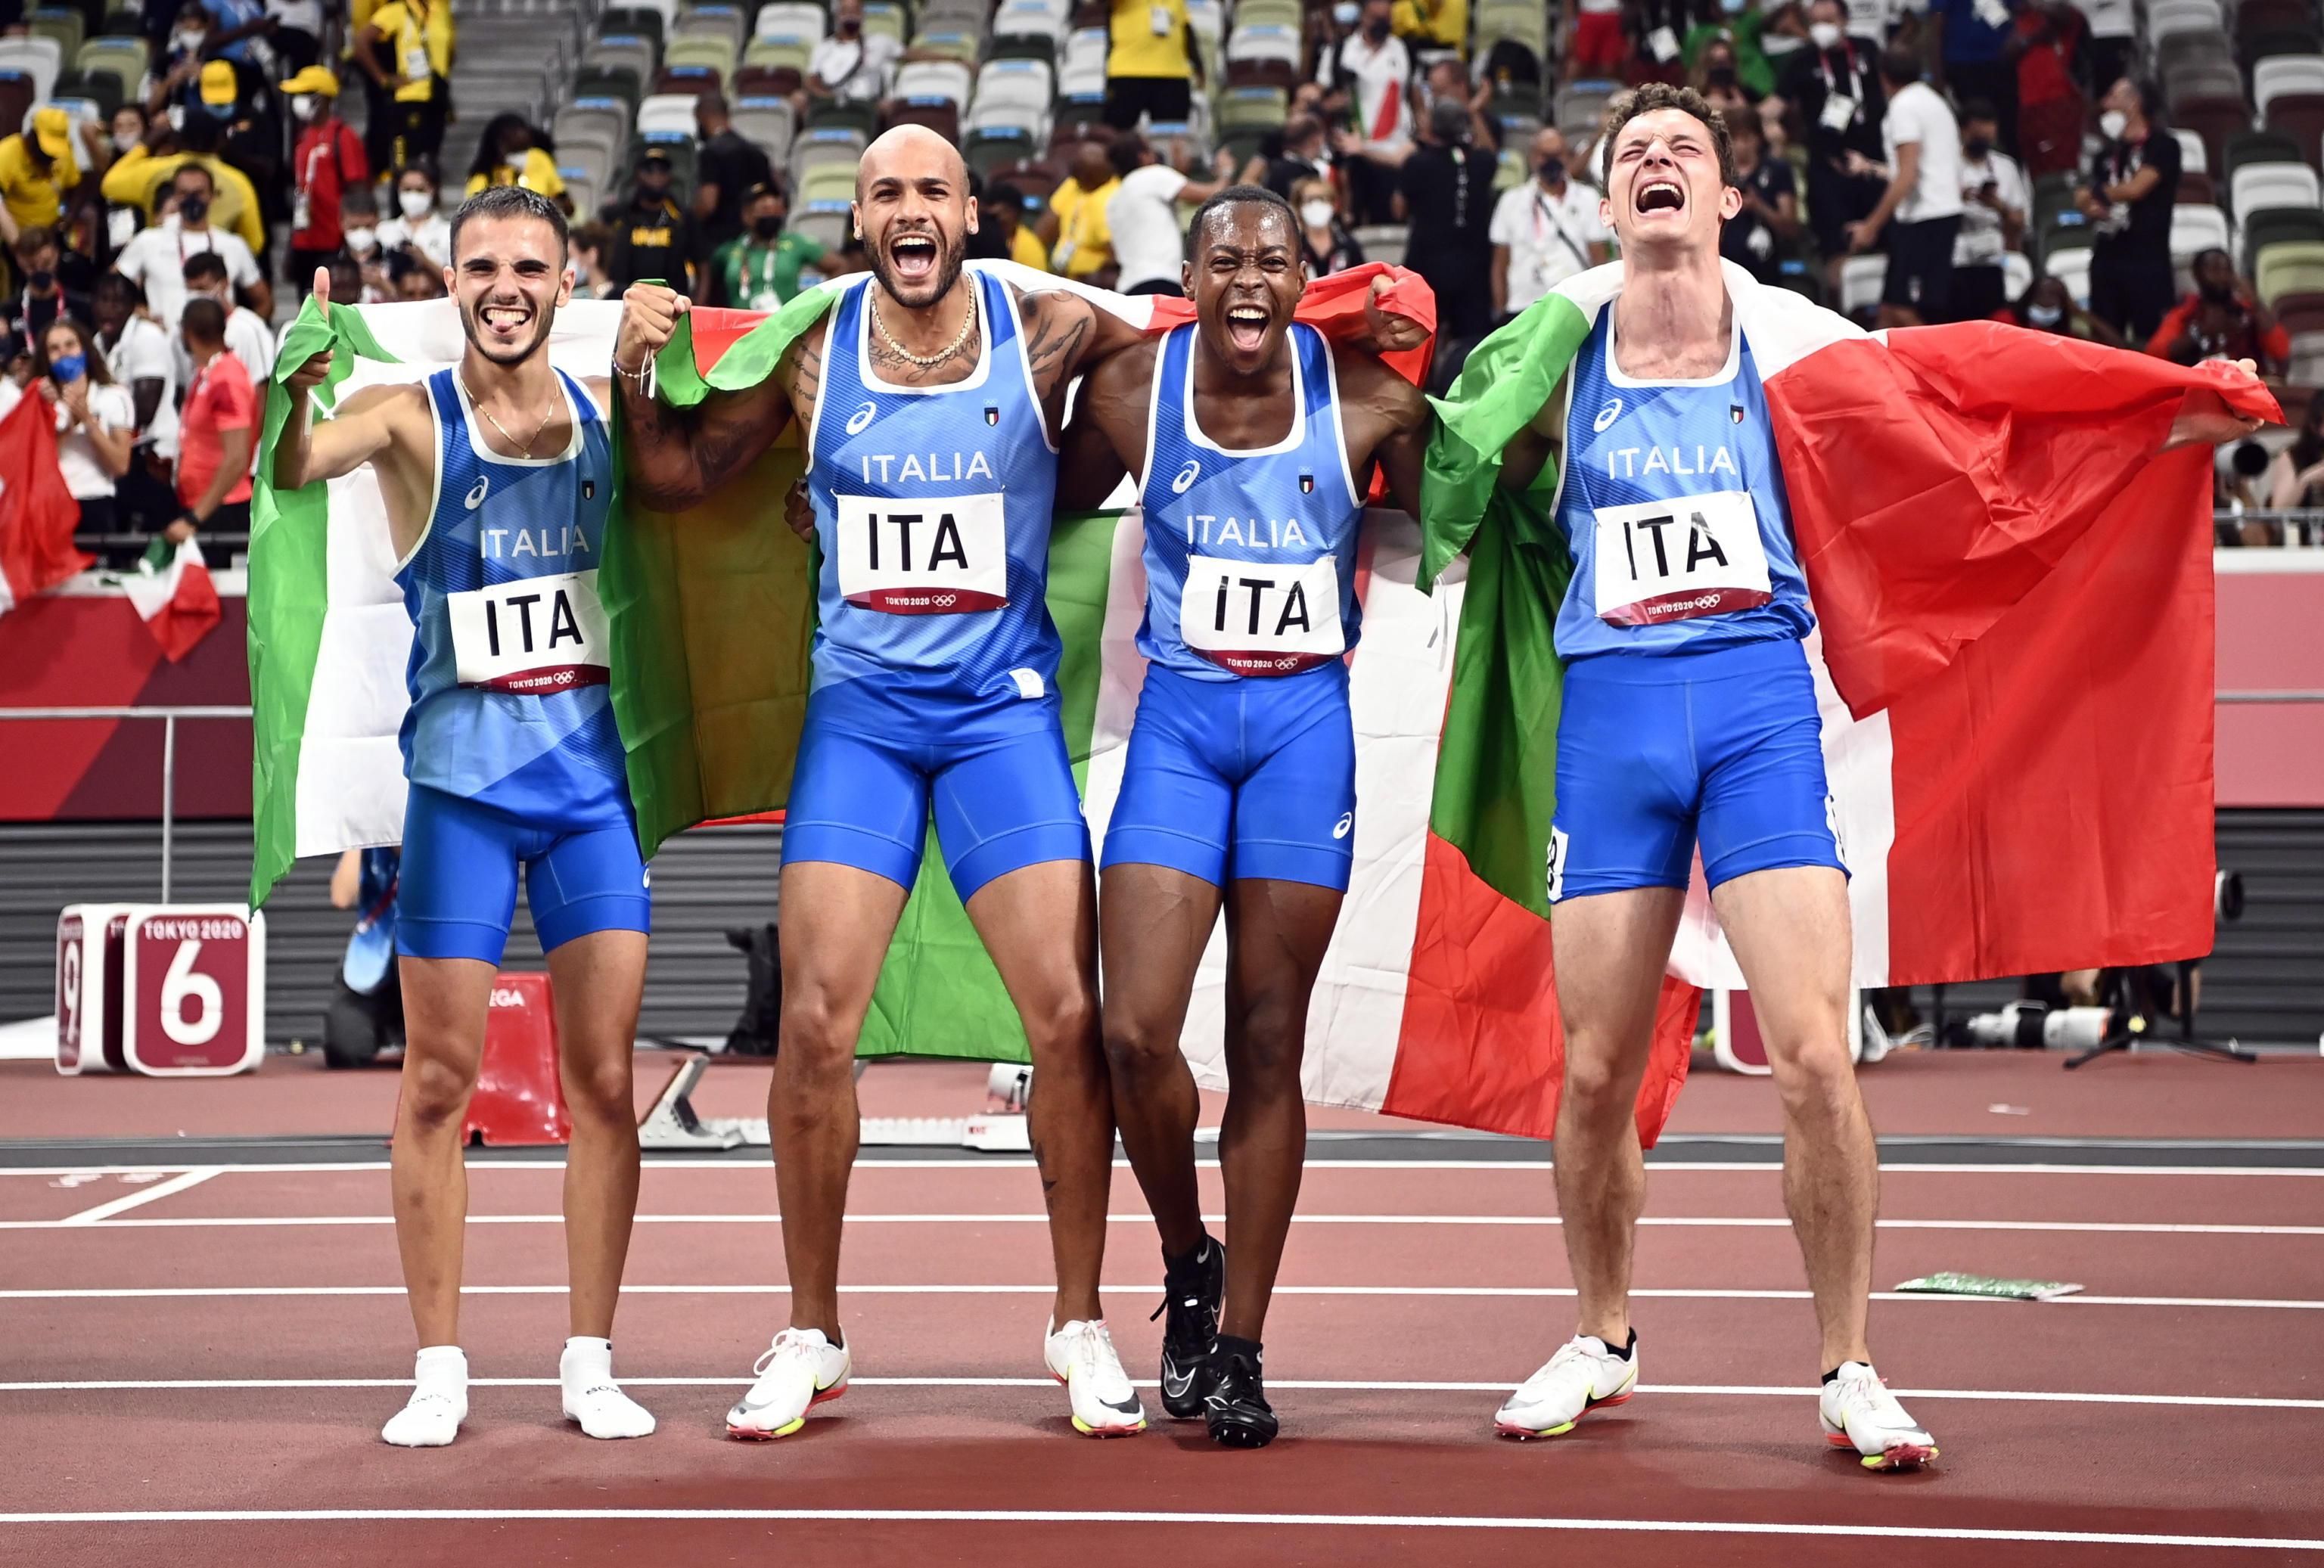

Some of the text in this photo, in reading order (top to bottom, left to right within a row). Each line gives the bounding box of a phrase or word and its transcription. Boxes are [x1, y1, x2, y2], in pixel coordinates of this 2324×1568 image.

[862, 451, 993, 484] ITALIA
[1608, 446, 1736, 480] ITALIA
[480, 525, 589, 558] ITALIA
[869, 514, 968, 571] ITA
[1188, 515, 1307, 548] ITALIA
[1623, 512, 1729, 580] ITA
[886, 597, 930, 606] TOKYO 2020
[1215, 576, 1310, 635] ITA
[1647, 601, 1693, 615] TOKYO 2020
[486, 589, 583, 656] ITA
[1227, 658, 1272, 668] TOKYO 2020
[508, 676, 552, 689] TOKYO 2020
[144, 919, 199, 939] TOKYO
[200, 919, 244, 939] 2020
[160, 939, 223, 1045] 6
